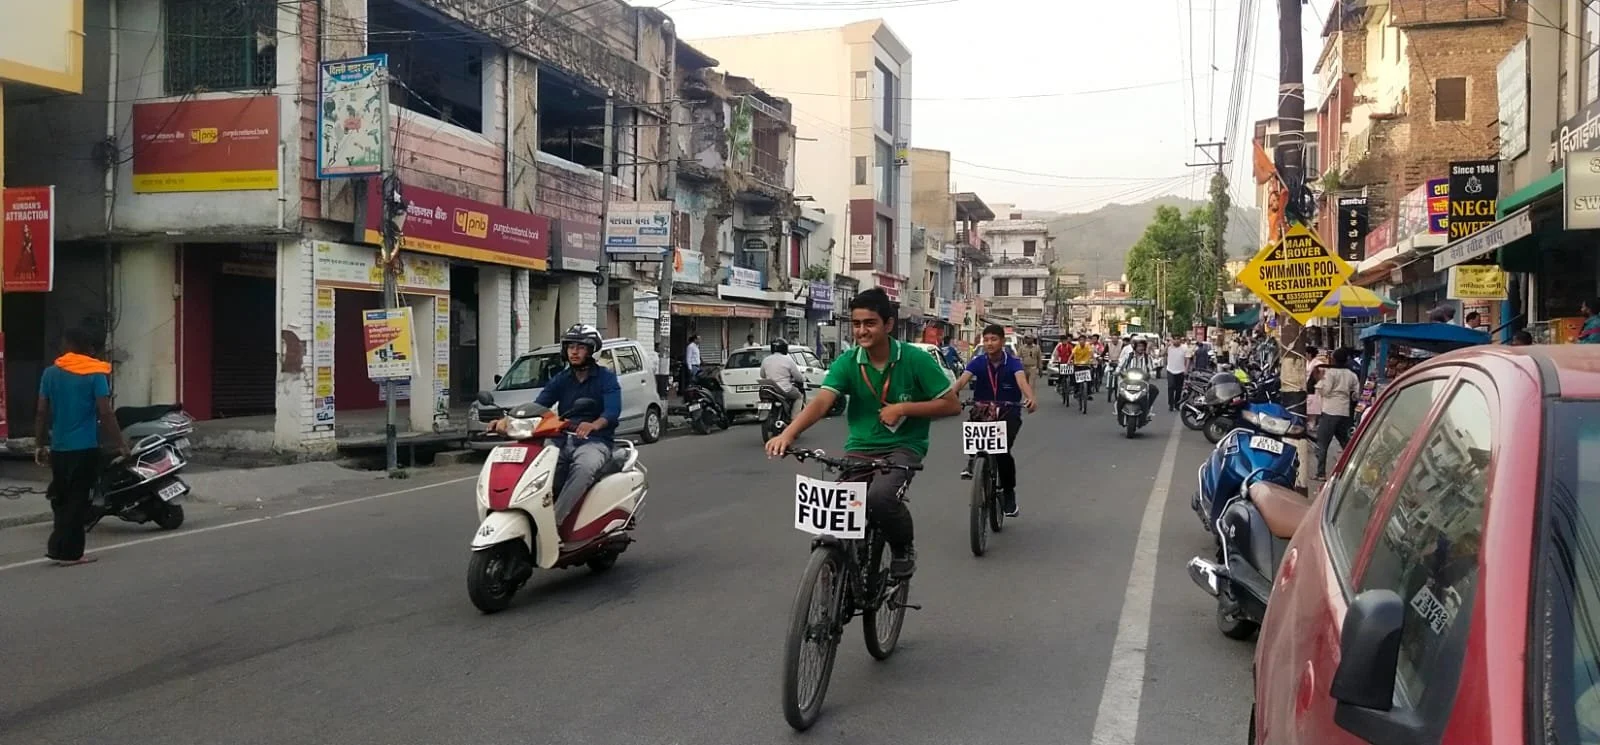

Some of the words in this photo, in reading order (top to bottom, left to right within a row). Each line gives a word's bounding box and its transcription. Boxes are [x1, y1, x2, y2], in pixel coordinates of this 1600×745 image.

[1453, 166, 1474, 175] Since
[1452, 200, 1495, 216] NEGI
[1575, 195, 1600, 210] SW
[6, 210, 48, 220] ATTRACTION
[469, 217, 486, 233] pnb
[1285, 238, 1312, 248] MAAN
[1275, 247, 1321, 259] SAROVER
[1260, 263, 1310, 280] SWIMMING
[1314, 260, 1340, 275] POOL
[1268, 277, 1332, 291] RESTAURANT
[965, 425, 996, 438] SAVE
[966, 438, 1005, 450] FUEL
[798, 482, 848, 509] SAVE
[798, 503, 861, 531] FUEL
